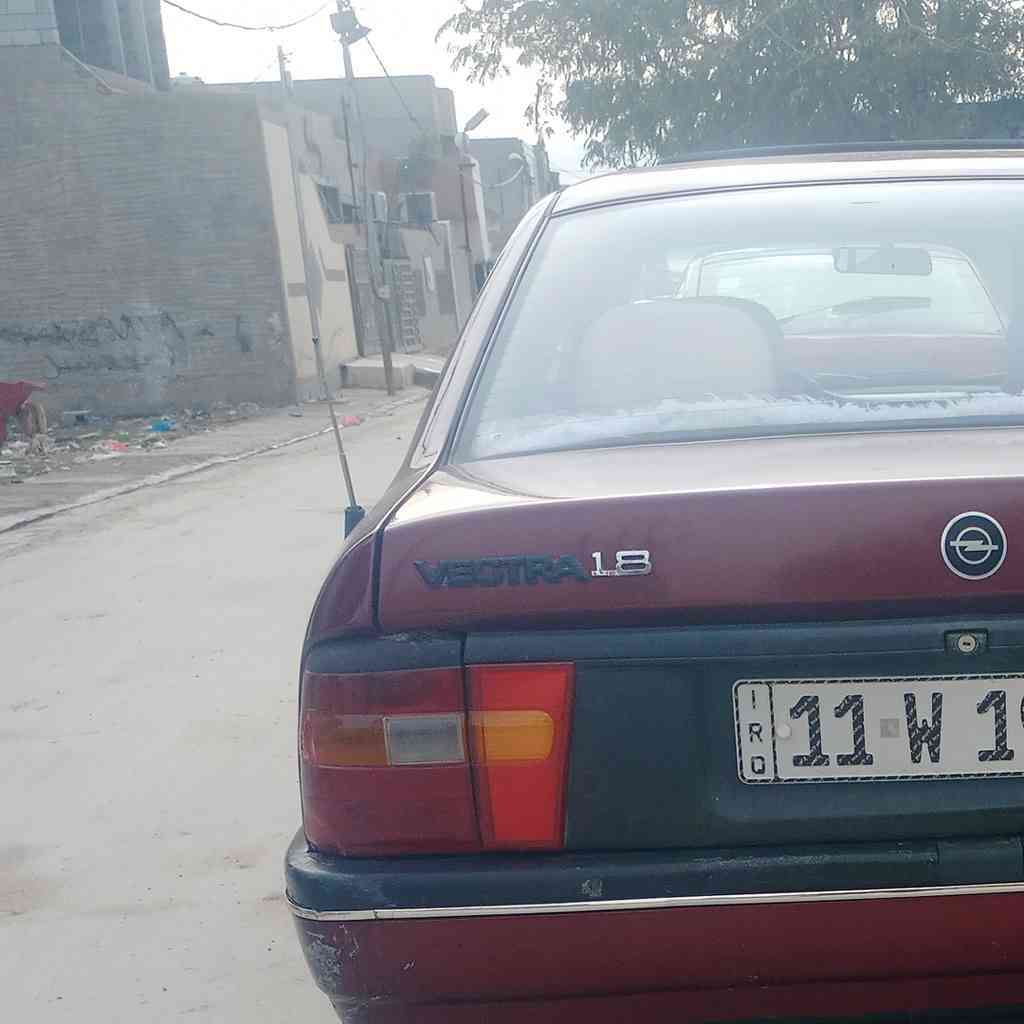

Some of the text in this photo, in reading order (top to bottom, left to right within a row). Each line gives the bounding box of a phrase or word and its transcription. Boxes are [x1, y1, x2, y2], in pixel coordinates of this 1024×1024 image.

[413, 554, 592, 590] VECTRA
[789, 694, 874, 767] 11
[903, 692, 943, 763] W
